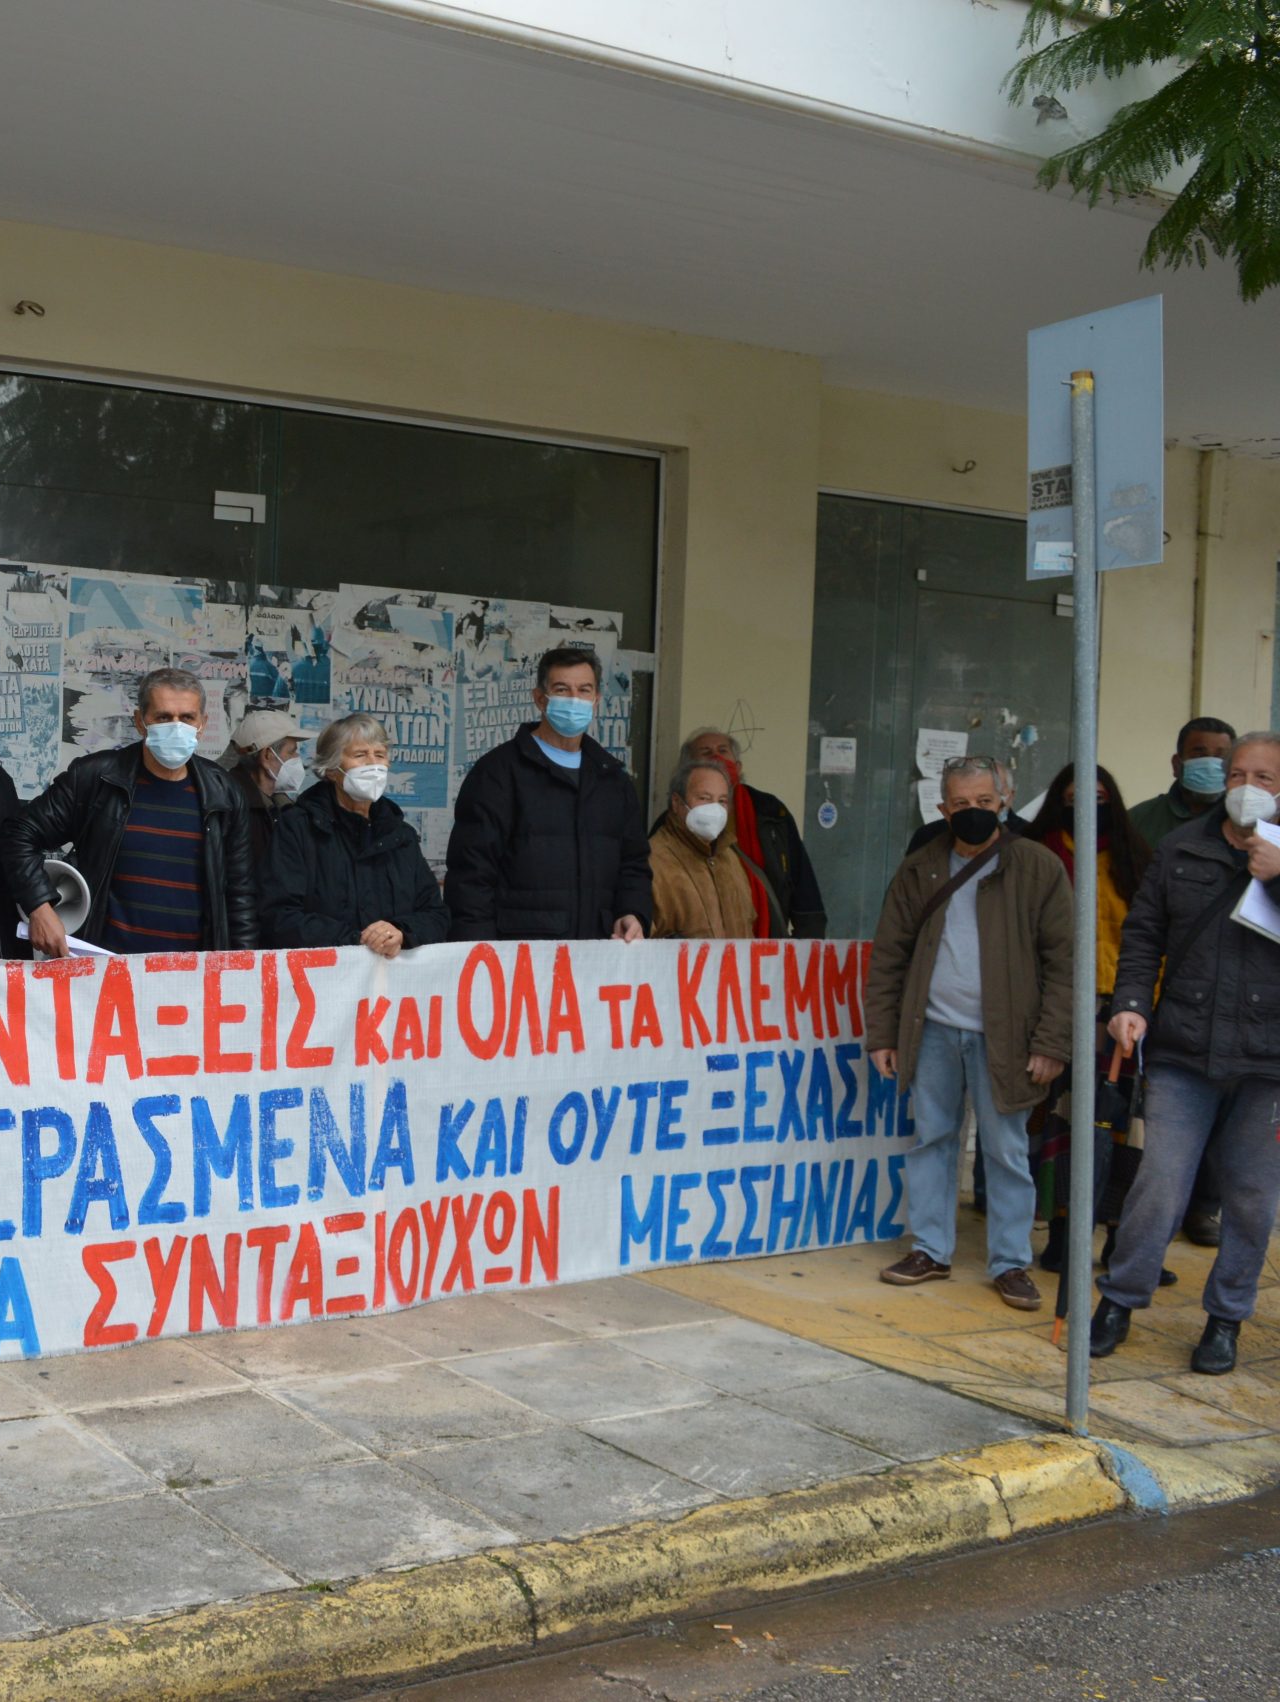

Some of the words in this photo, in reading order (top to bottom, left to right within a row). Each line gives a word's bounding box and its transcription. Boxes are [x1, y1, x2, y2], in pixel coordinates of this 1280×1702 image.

[379, 714, 446, 746] ΑΤΩΝ
[465, 722, 520, 750] ΕΡΓΑΤ
[354, 995, 442, 1067] ΚΑΙ
[457, 942, 586, 1061] ΟΛΑ
[599, 982, 664, 1050] ΤΑ
[436, 1095, 528, 1183] ΚΑΙ
[548, 1079, 688, 1166] ΟΥΤΕ
[82, 1185, 560, 1348] ΣΥΝΤΑΞΙΟΥΧΩΝ
[620, 1154, 906, 1266] ΜΕΣΣΗΝΙΑΣ
